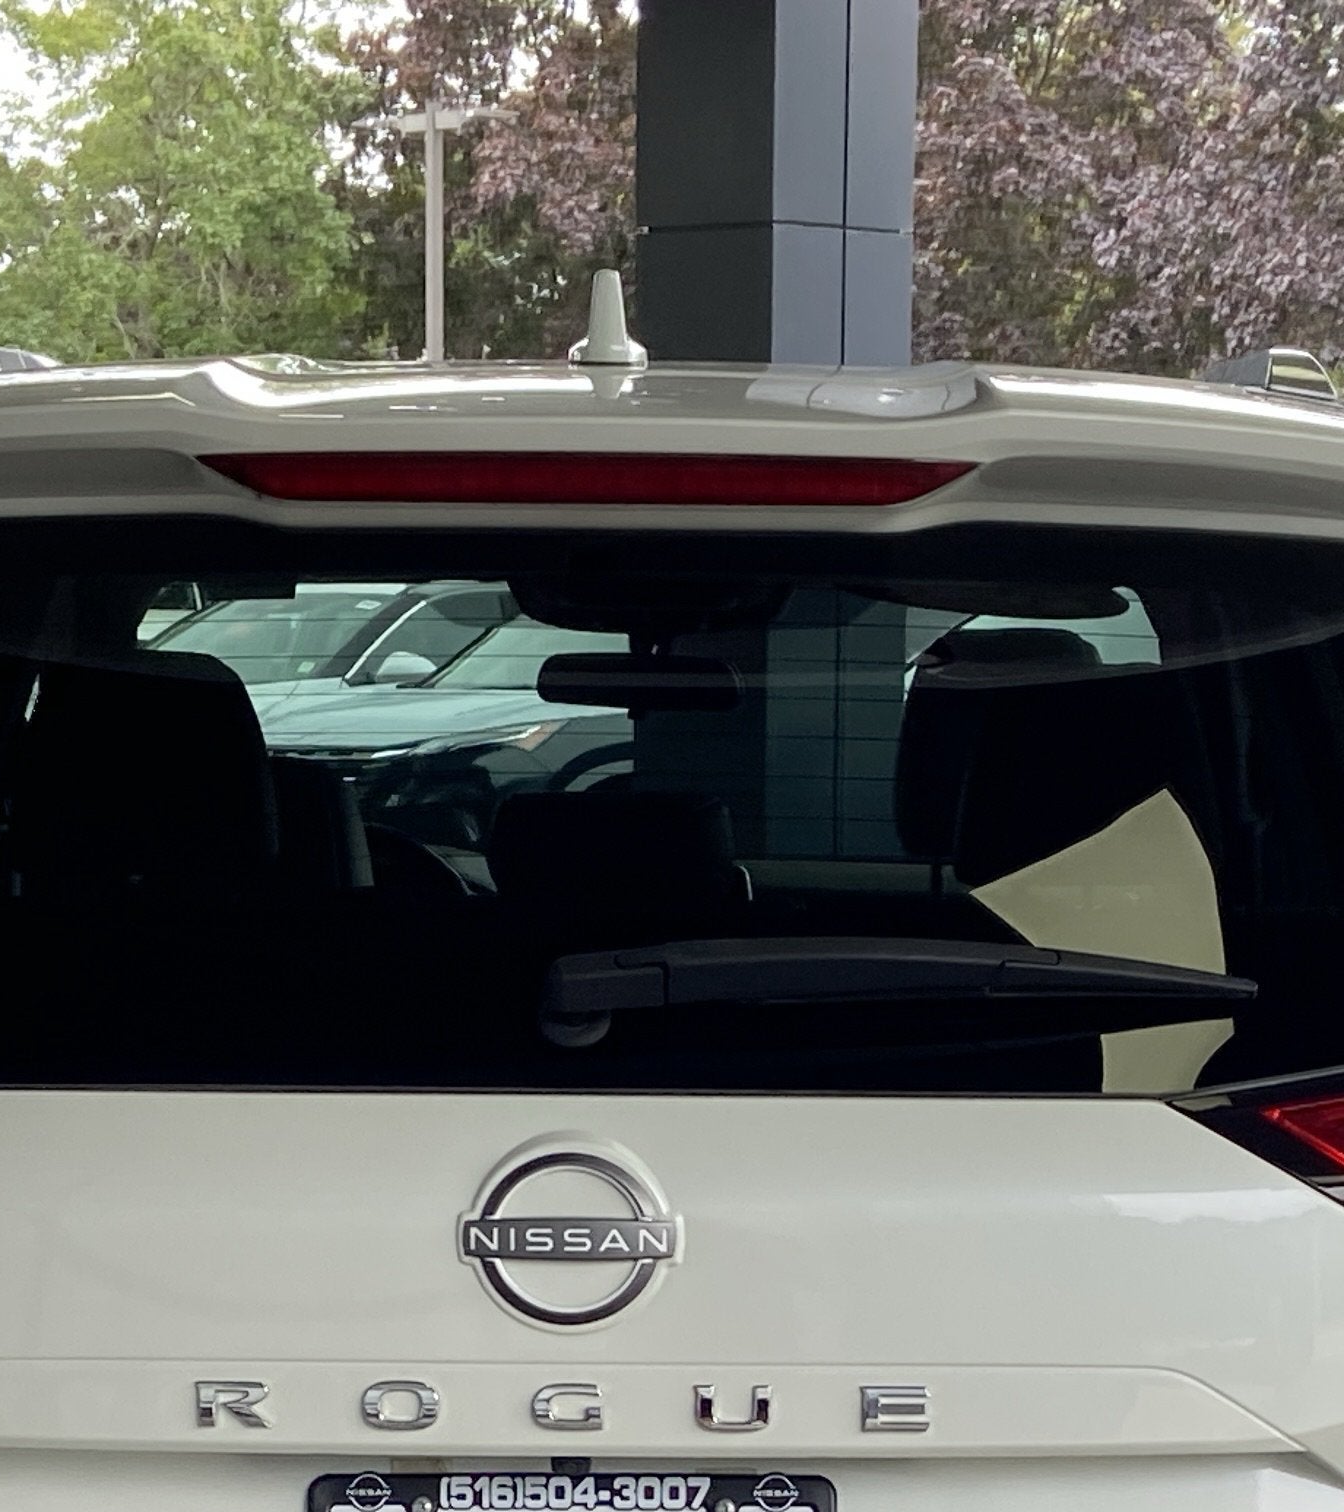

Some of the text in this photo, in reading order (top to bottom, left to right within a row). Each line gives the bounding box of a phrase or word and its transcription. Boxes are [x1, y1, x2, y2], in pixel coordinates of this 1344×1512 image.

[468, 1223, 672, 1254] NISSAN
[194, 1380, 934, 1430] ROGUE
[345, 1487, 393, 1497] NISSAN
[439, 1475, 711, 1511] (516)504-3007
[753, 1488, 800, 1498] NISSAN
